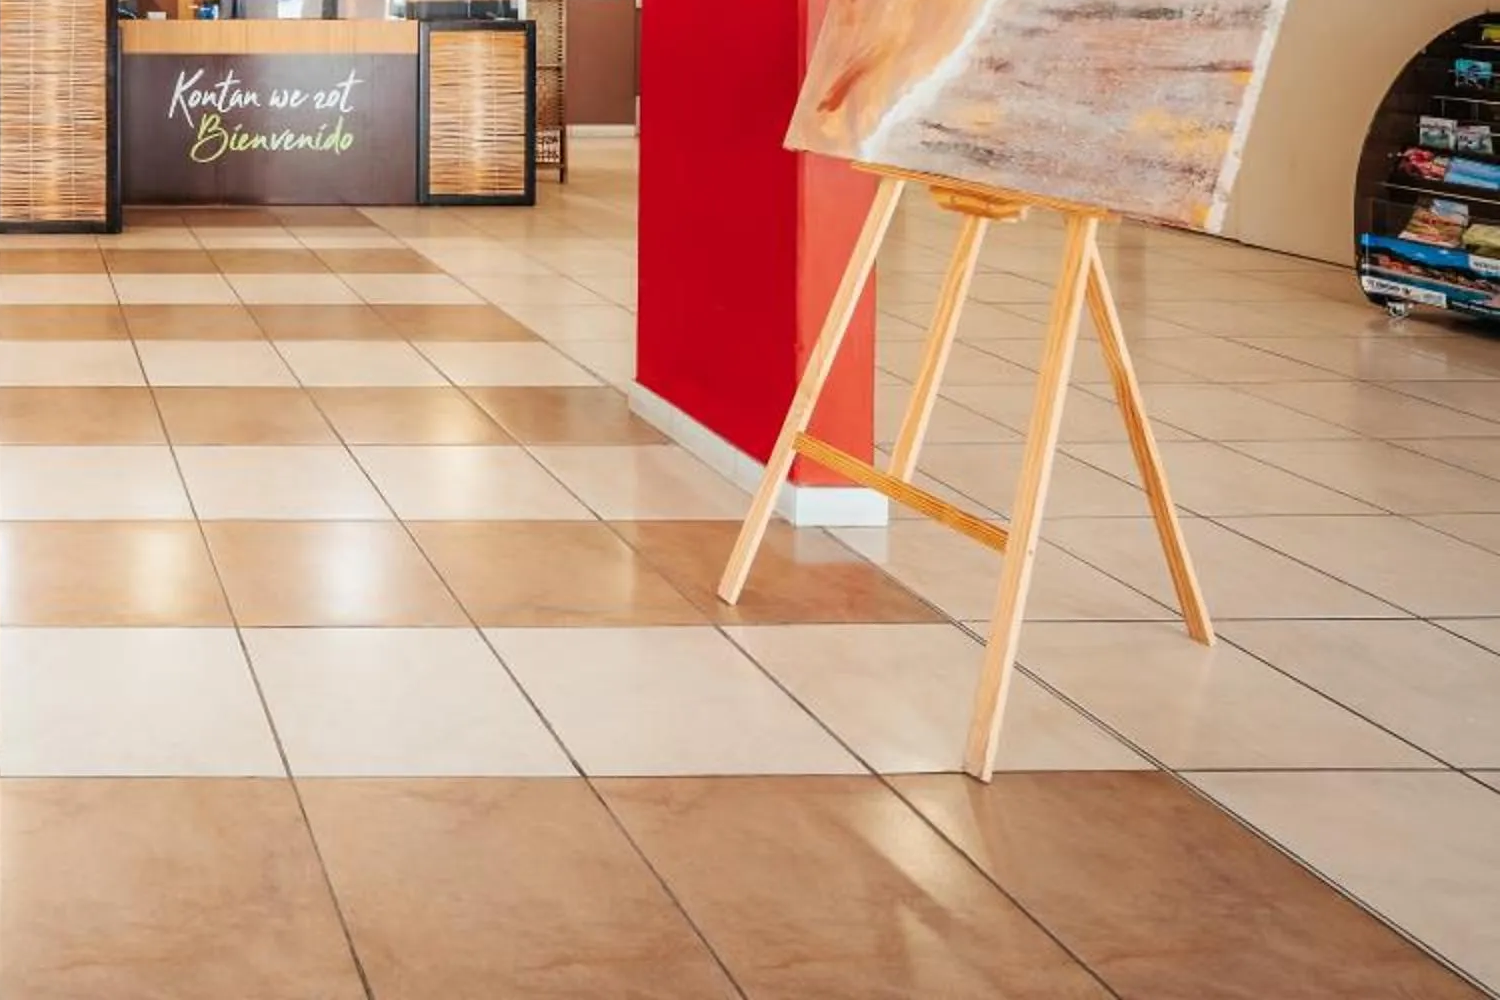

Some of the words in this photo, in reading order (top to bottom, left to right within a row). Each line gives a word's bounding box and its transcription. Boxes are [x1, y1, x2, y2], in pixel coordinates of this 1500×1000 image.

[168, 68, 260, 128] Kontan
[269, 87, 308, 109] we
[314, 68, 364, 112] zot
[190, 113, 353, 163] Bienvenido
